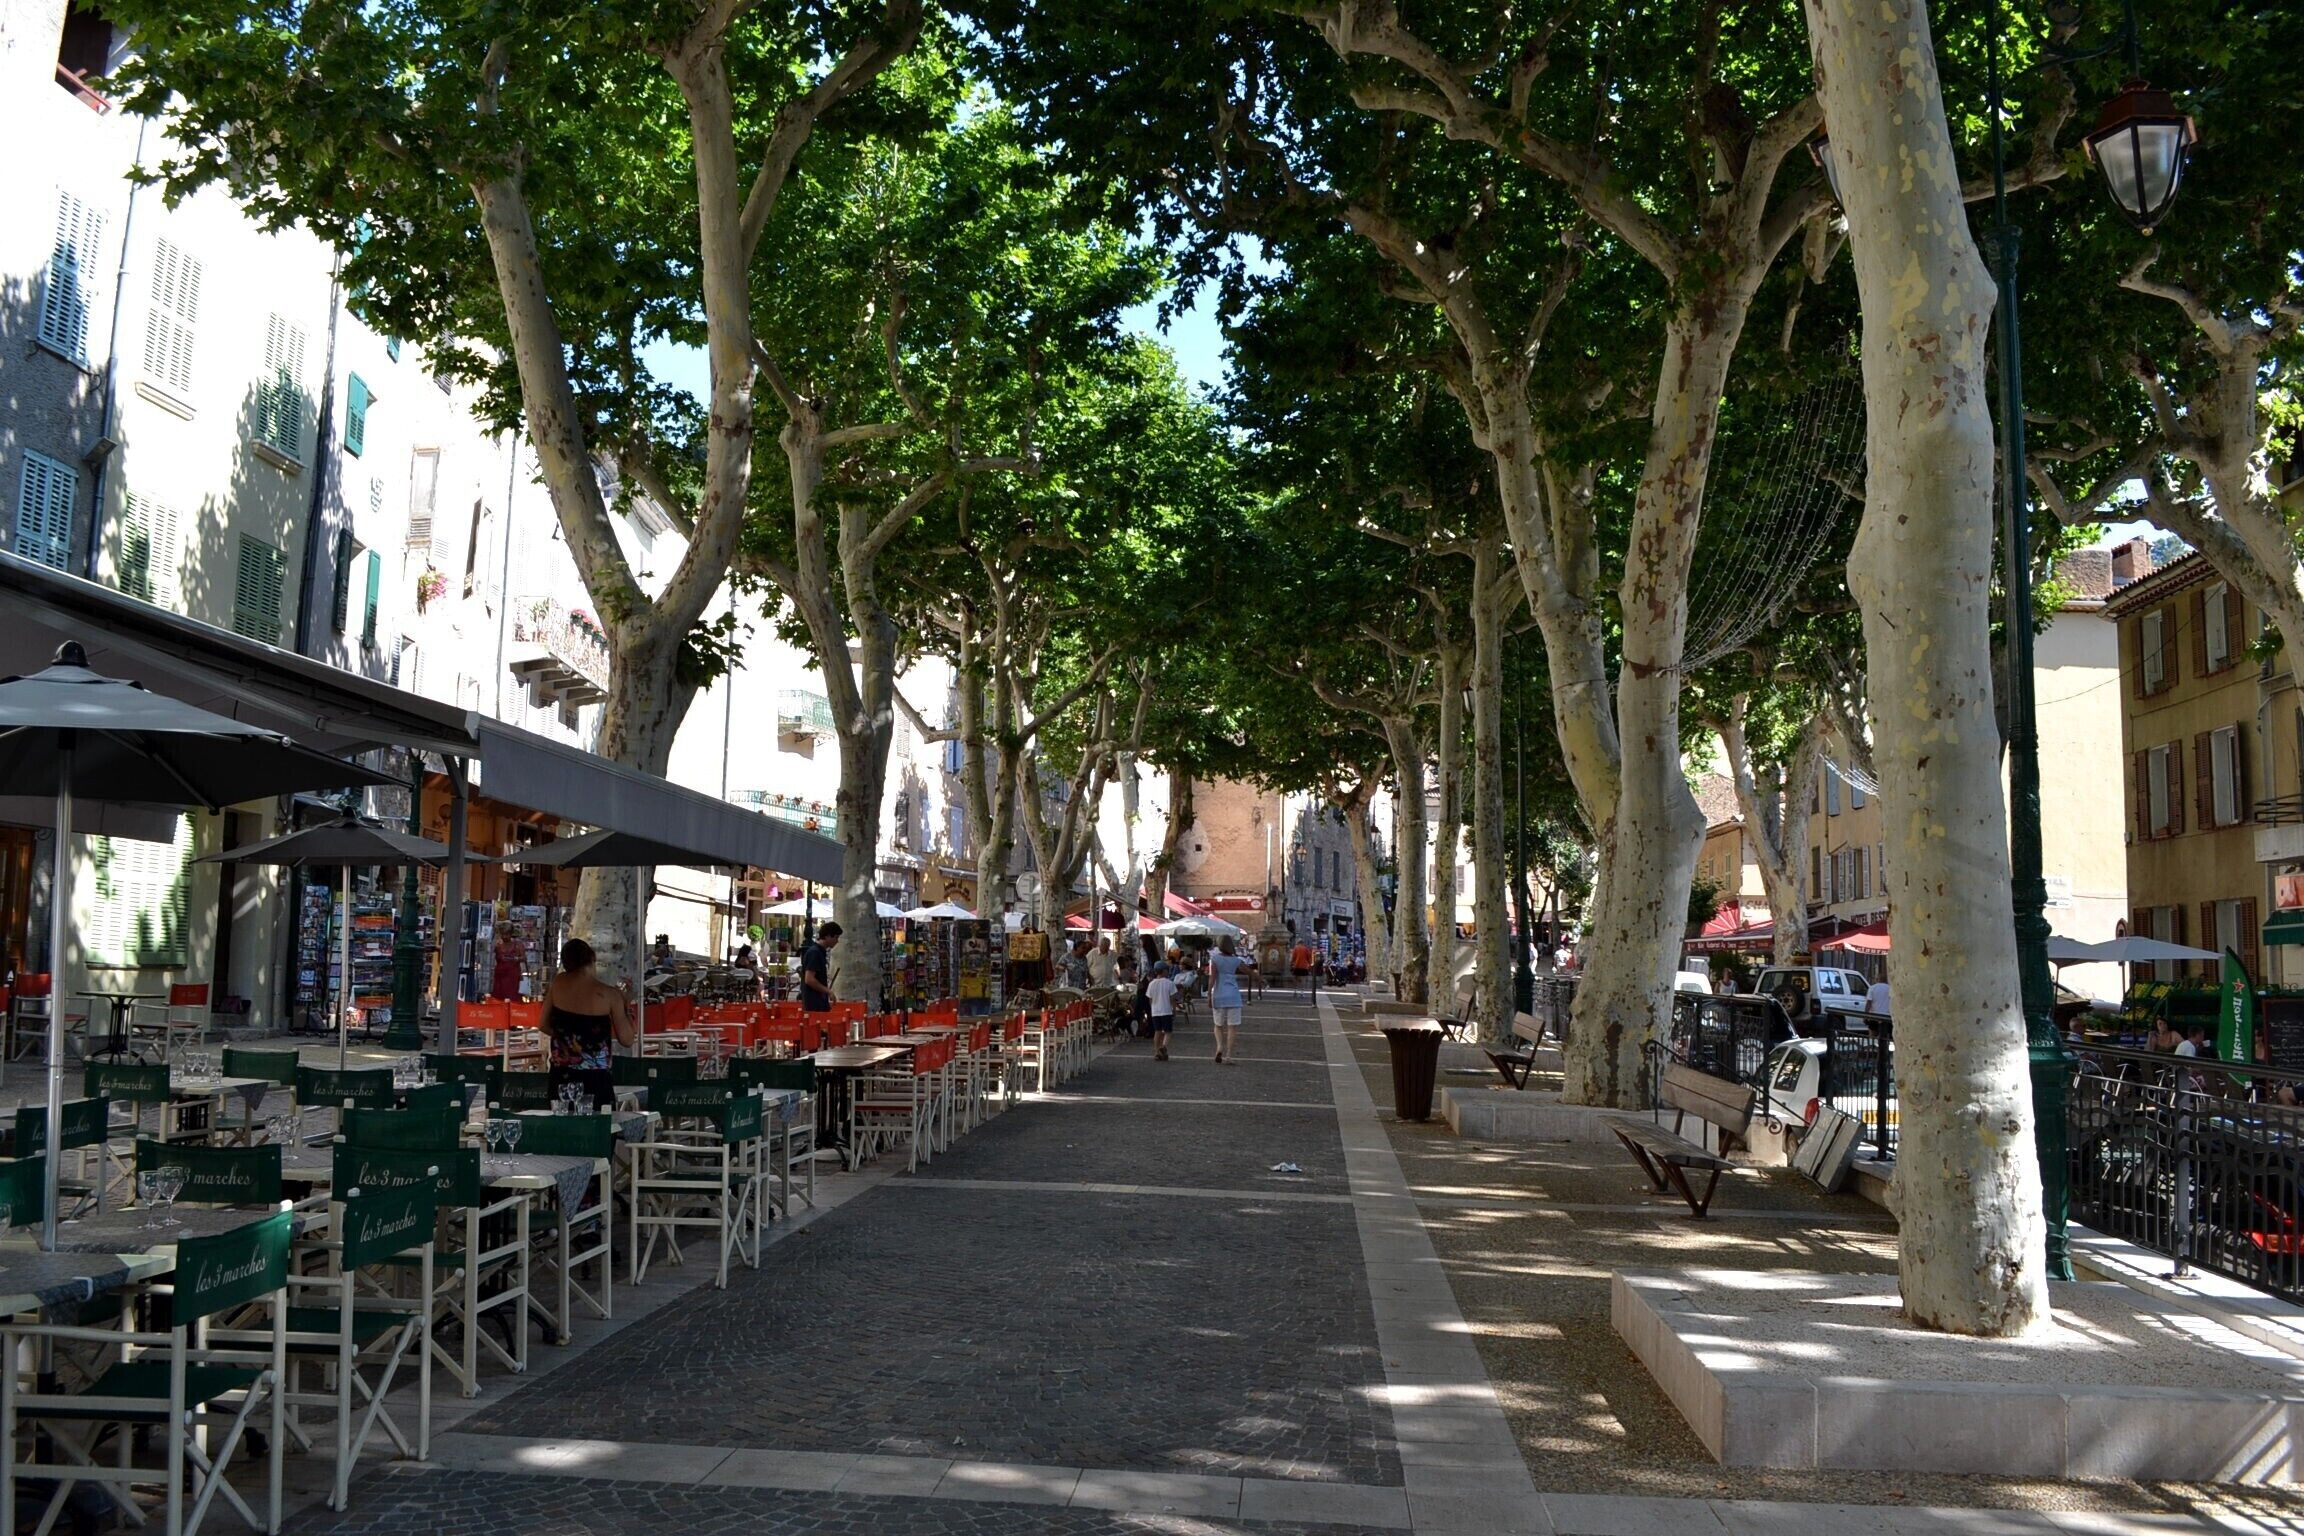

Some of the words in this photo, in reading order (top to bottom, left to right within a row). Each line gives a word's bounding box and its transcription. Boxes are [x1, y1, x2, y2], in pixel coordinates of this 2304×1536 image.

[313, 1080, 326, 1095] les
[335, 1080, 376, 1096] marches
[665, 1089, 679, 1105] les
[183, 1167, 191, 1184] 3
[193, 1161, 254, 1185] marches
[358, 1162, 378, 1186] les
[379, 1169, 391, 1186] 3
[360, 1213, 375, 1243] les
[374, 1218, 383, 1240] 3
[381, 1201, 417, 1237] marches
[195, 1260, 212, 1293] les
[213, 1264, 223, 1288] 3
[223, 1243, 268, 1285] marches
